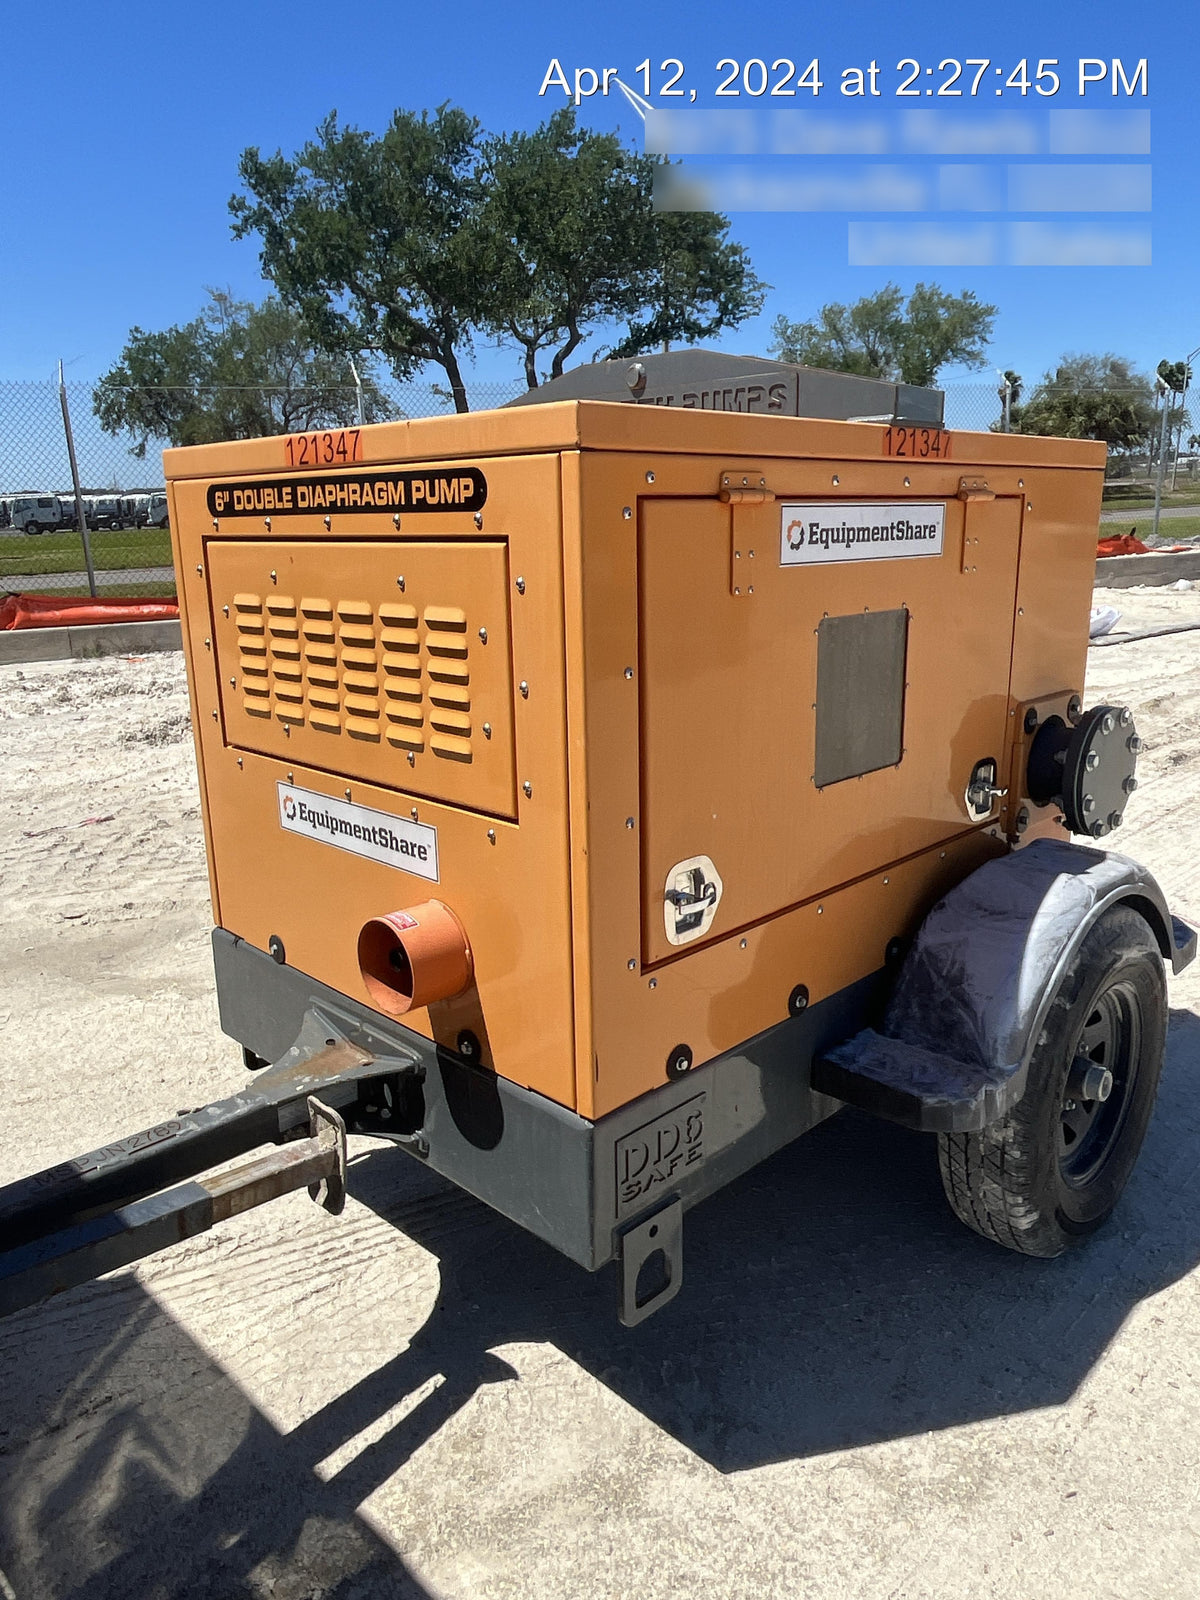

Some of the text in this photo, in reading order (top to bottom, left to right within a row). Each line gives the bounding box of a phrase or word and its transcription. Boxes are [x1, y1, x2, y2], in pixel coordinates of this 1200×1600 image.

[682, 384, 787, 414] PUMPS
[286, 429, 360, 466] 121347
[885, 427, 951, 458] 121347
[214, 477, 474, 512] 6" DOUBLE DIAPHRAGM PUMP
[808, 520, 937, 549] EquipmentShare
[298, 802, 428, 862] EquipmentShare
[621, 1141, 703, 1203] SAFE
